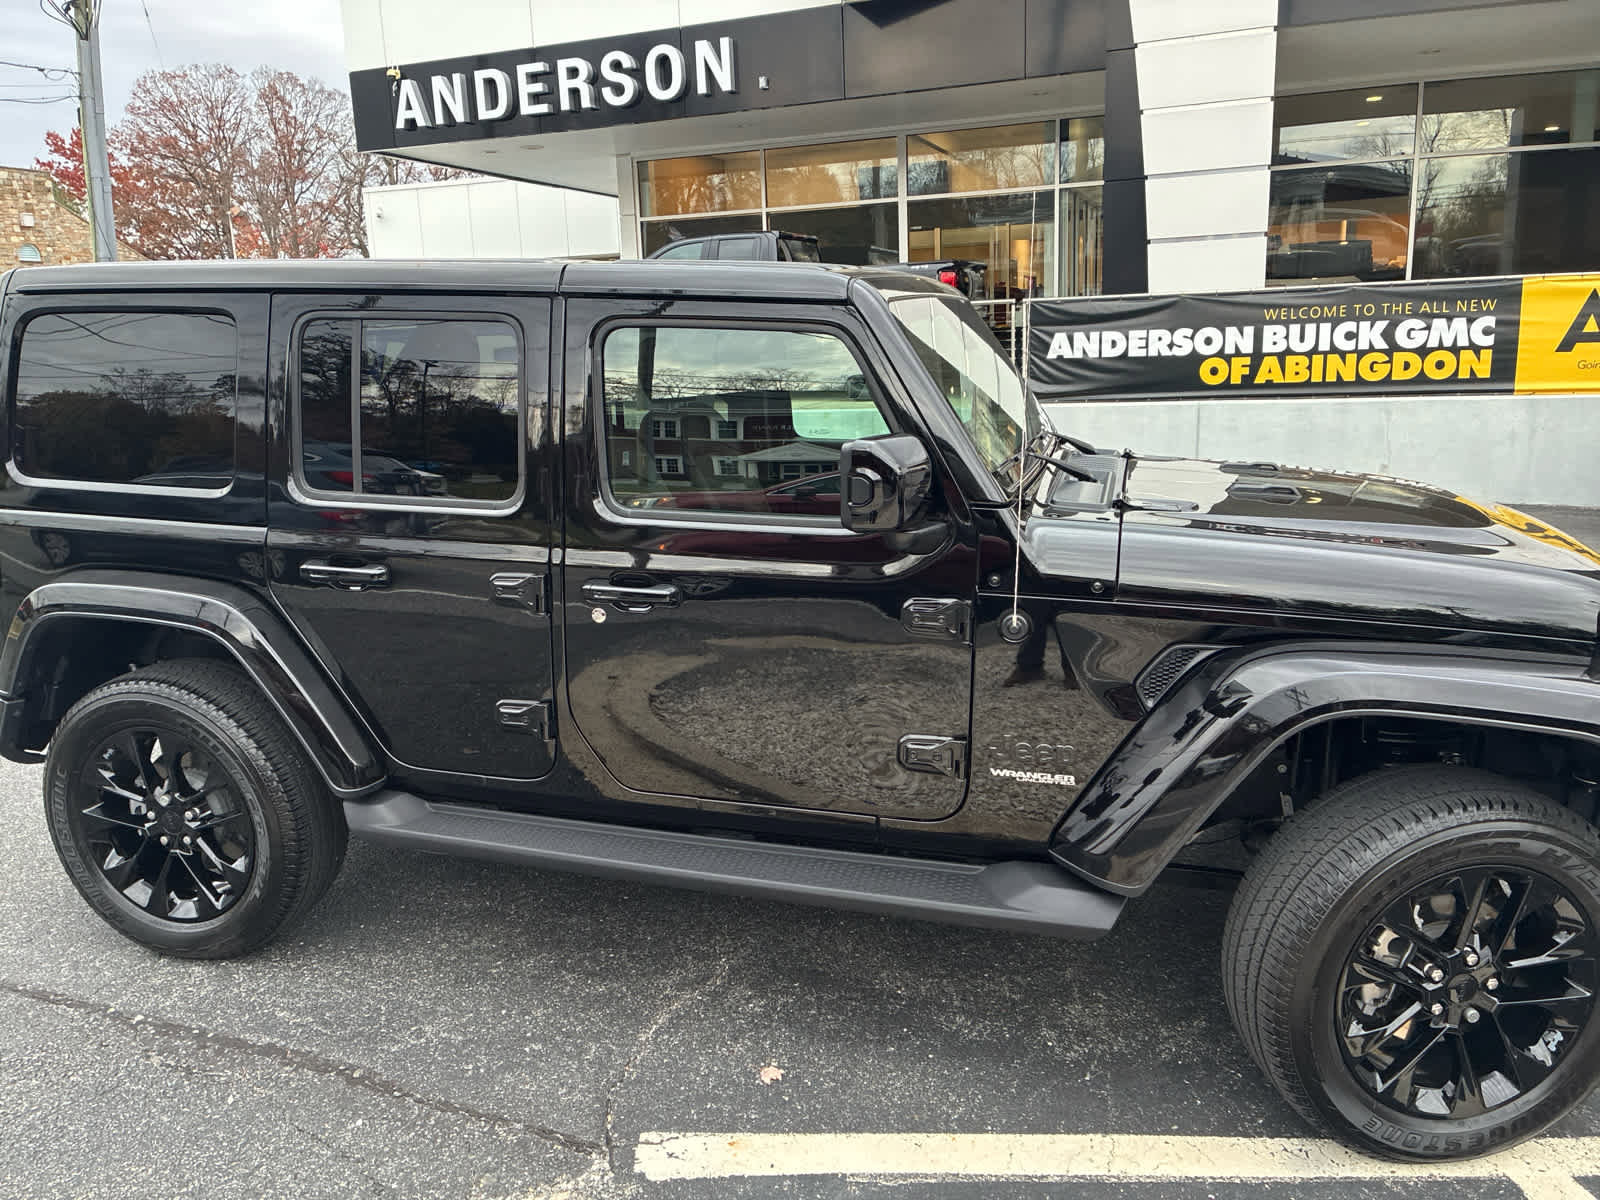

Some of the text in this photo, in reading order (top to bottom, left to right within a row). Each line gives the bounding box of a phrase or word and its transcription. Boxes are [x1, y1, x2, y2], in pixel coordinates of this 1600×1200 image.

[395, 36, 736, 131] ANDERSON
[1264, 299, 1497, 320] WELCOME TO THE ALL NEW
[1046, 315, 1497, 359] ANDERSON BUICK GMC
[1199, 348, 1494, 386] OF ABINGDON
[989, 767, 1076, 783] WRANGLER
